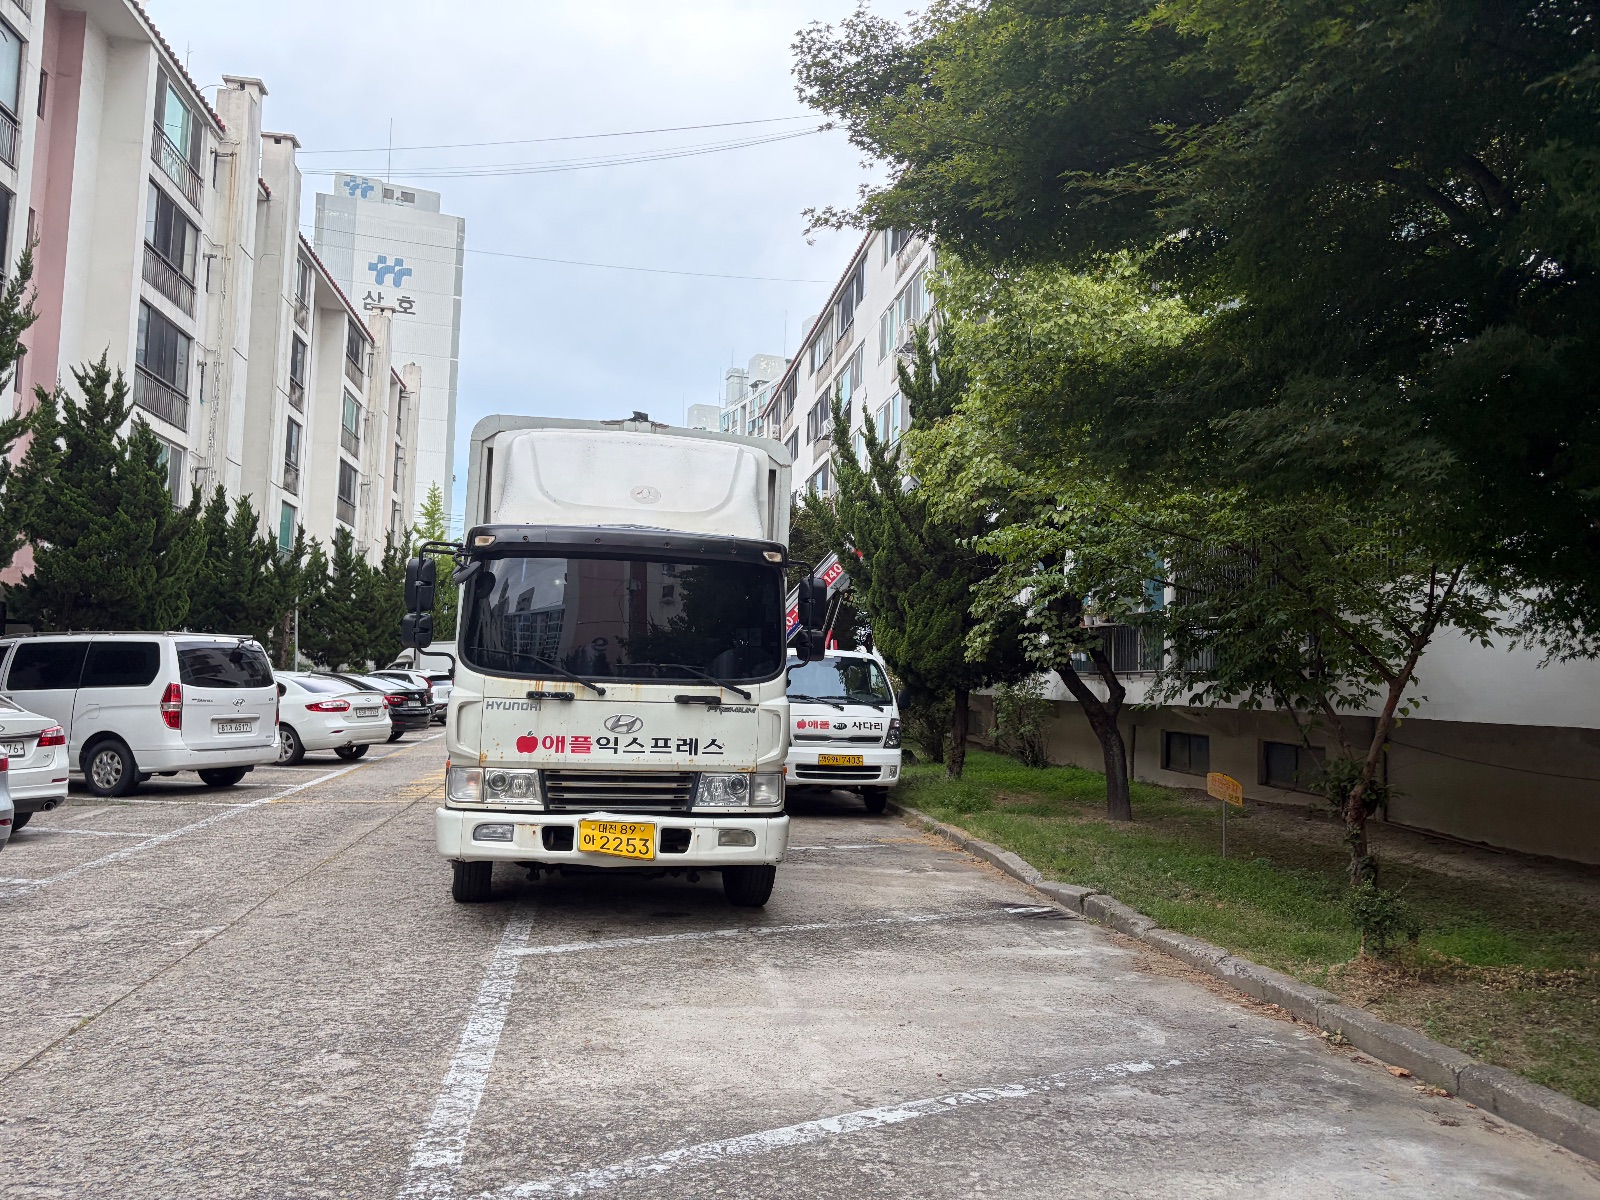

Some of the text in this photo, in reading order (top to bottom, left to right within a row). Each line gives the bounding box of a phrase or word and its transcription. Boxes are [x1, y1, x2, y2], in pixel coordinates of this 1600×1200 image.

[362, 290, 417, 315] 삼호
[823, 563, 843, 584] 140
[485, 700, 542, 711] HYUNDAI
[707, 705, 757, 715] PREMIUM
[807, 720, 883, 732] 애플 사다리
[598, 823, 637, 835] 대전 89
[583, 834, 650, 856] 아 2253
